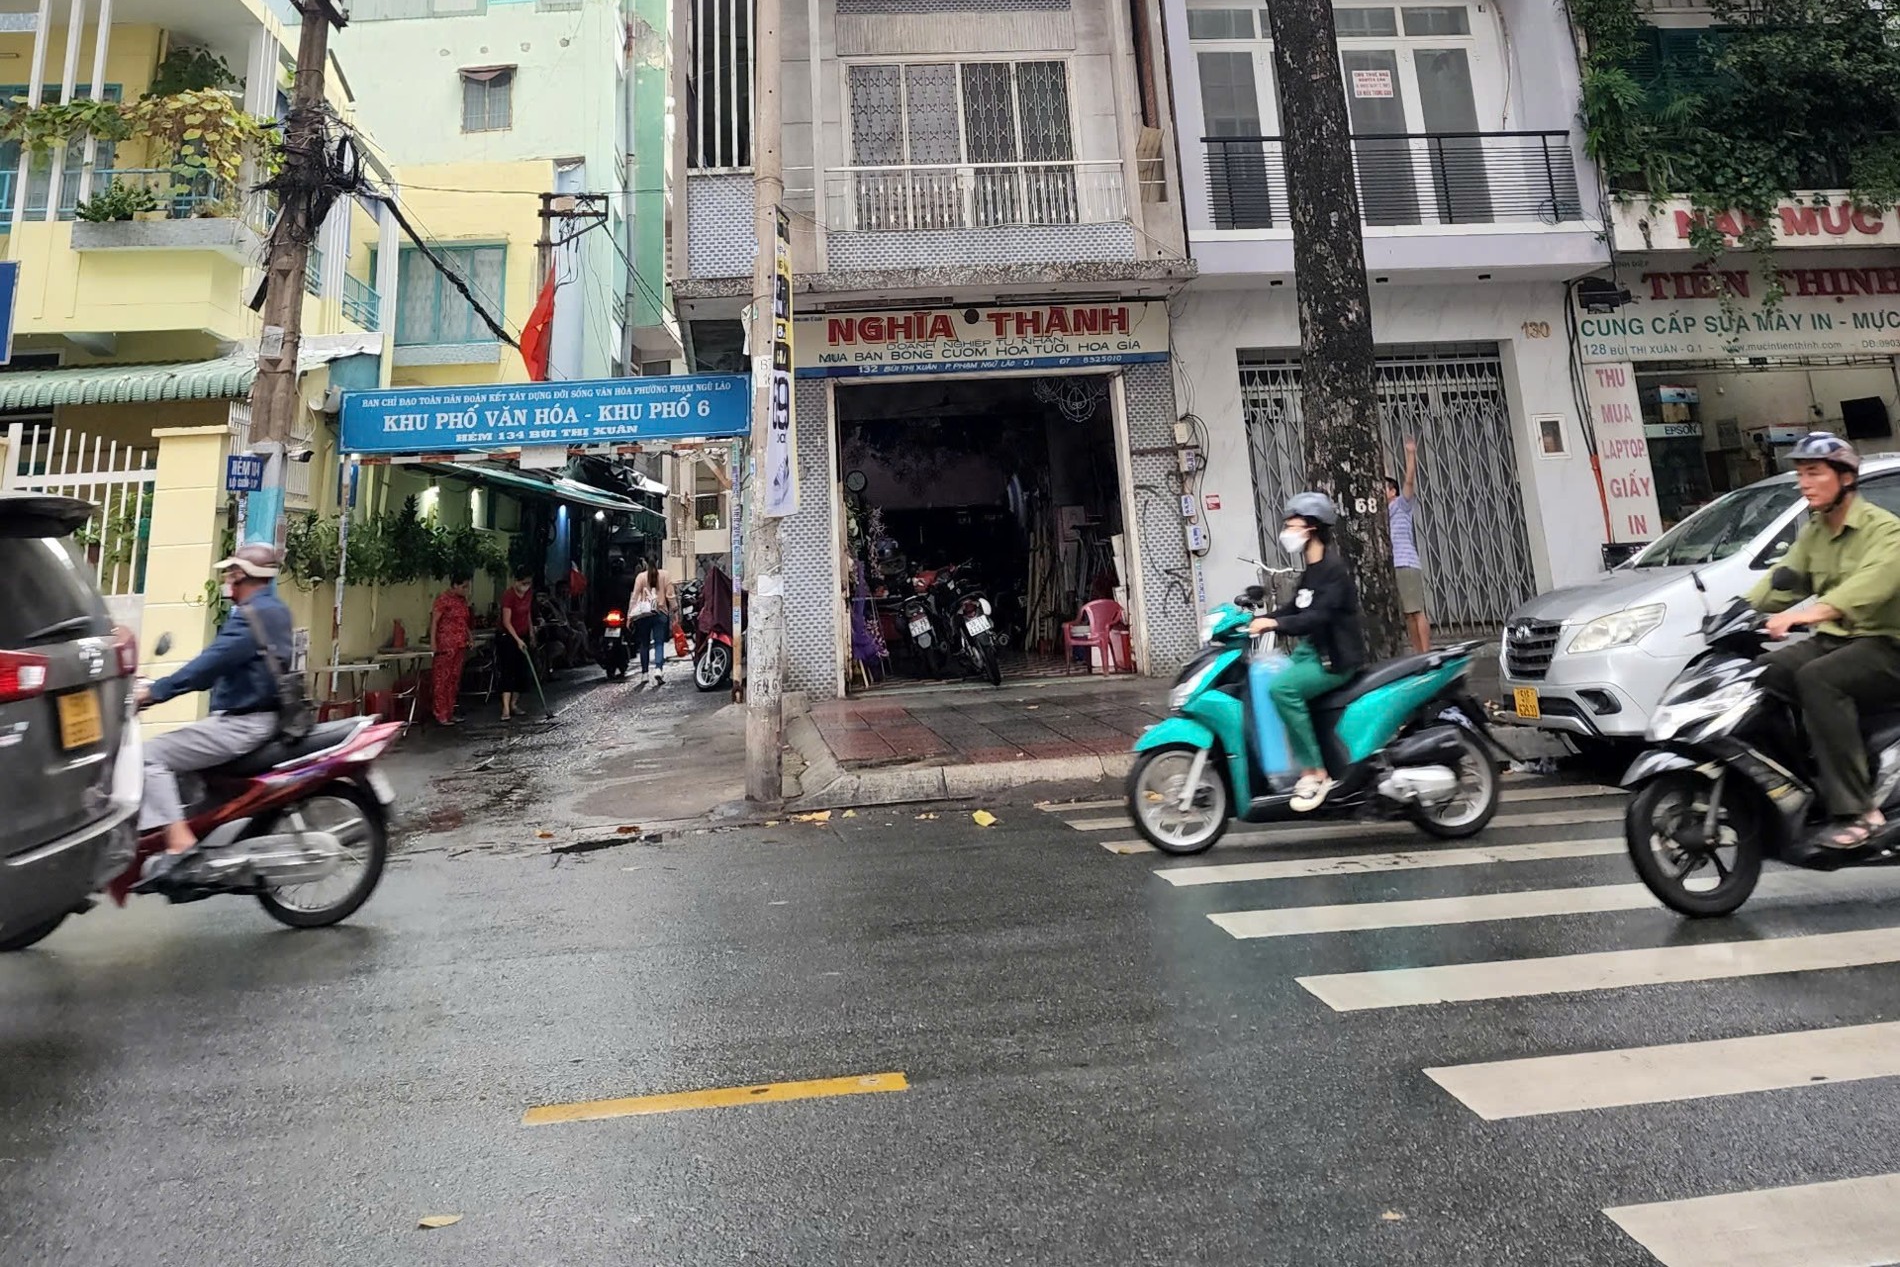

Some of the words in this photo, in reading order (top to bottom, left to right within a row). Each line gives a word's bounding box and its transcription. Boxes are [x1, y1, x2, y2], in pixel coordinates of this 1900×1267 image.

[828, 312, 959, 347] NGHĨA
[1521, 321, 1550, 339] 130
[1580, 317, 1645, 337] CUNG
[1651, 309, 1697, 334] CẤP
[1810, 313, 1833, 331] IN
[886, 342, 936, 351] DOANH
[1583, 344, 1607, 356] 128
[818, 352, 848, 364] MUA
[858, 364, 878, 374] 132
[1595, 368, 1626, 388] THU
[361, 398, 380, 408] BAN
[381, 395, 398, 407] CHỈ
[418, 395, 442, 405] TOÀN
[382, 413, 429, 433] KHU
[435, 403, 480, 430] PHỐ
[484, 405, 528, 428] VĂN
[533, 402, 580, 426] HÓA
[597, 403, 643, 423] KHU
[648, 393, 692, 419] PHỐ
[697, 399, 711, 417] 6
[1600, 402, 1633, 424] MUA
[498, 430, 525, 441] 134
[593, 424, 639, 436] XUÂN
[1664, 423, 1697, 435] EPSON
[1602, 437, 1645, 459] LAPTOP
[1609, 468, 1650, 498] GIẤY
[1355, 497, 1378, 514] 68
[1628, 514, 1648, 535] IN
